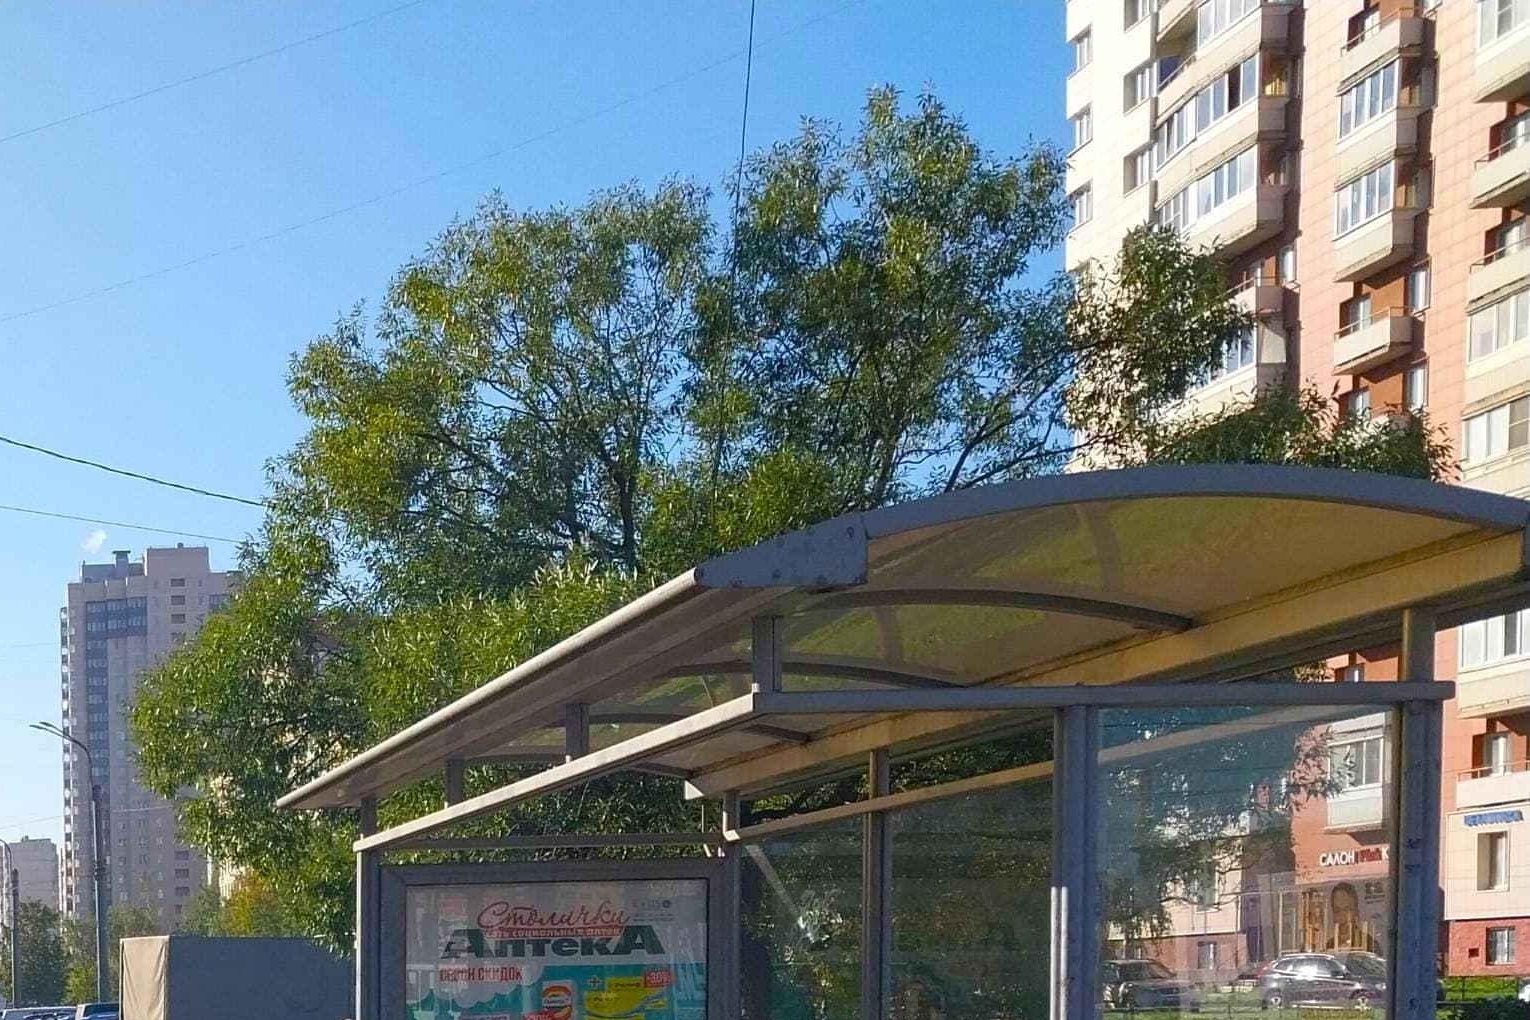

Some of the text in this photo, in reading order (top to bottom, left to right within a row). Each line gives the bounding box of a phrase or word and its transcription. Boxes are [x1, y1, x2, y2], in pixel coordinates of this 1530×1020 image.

[1320, 850, 1355, 866] САЛОН
[477, 901, 630, 928] Столички
[439, 966, 523, 982] СЕЗОН СКИДОК
[645, 970, 672, 985] -30%
